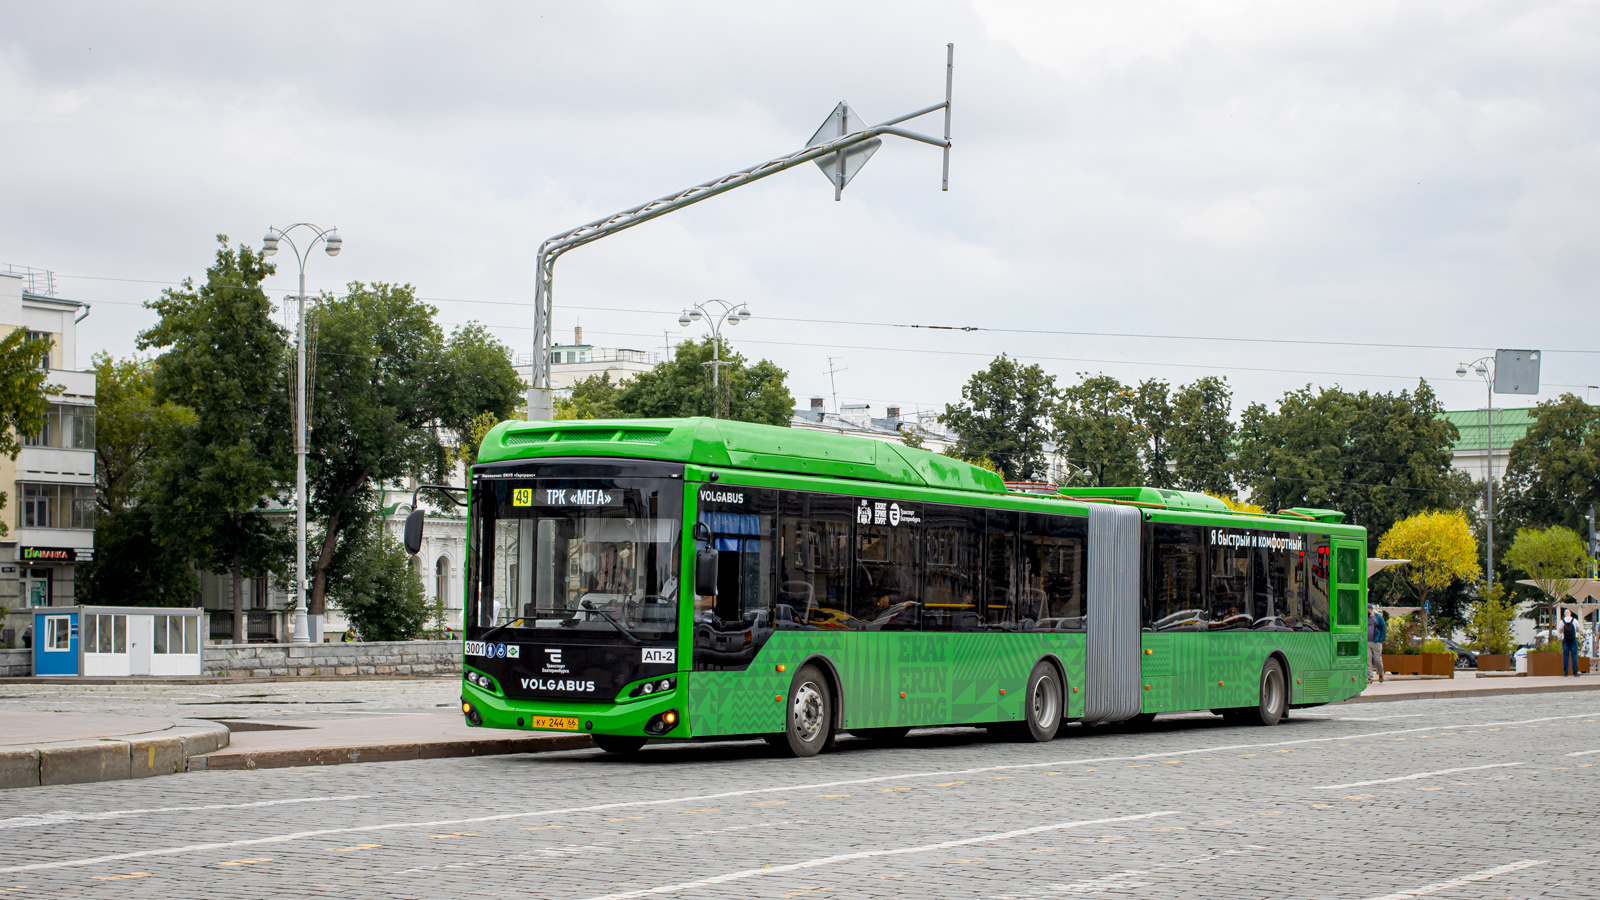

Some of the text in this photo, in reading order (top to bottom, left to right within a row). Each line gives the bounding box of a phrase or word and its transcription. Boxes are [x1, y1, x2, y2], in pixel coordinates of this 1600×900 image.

[516, 489, 529, 504] 49
[546, 489, 612, 504] ТРК «МЕГА»
[700, 490, 744, 504] VOLGABUS
[1211, 529, 1302, 553] Я быстрый и комфортный
[466, 642, 485, 655] 3001
[898, 635, 949, 663] EKAT
[1207, 634, 1243, 657] EKAT
[644, 650, 673, 662] АП-2
[898, 666, 948, 694] ERIN
[1207, 660, 1243, 683] ERIN
[520, 678, 596, 692] VOLGABUS
[1207, 684, 1243, 707] BURG
[897, 696, 947, 726] BURG
[549, 717, 564, 728] 244
[568, 718, 576, 726] 66
